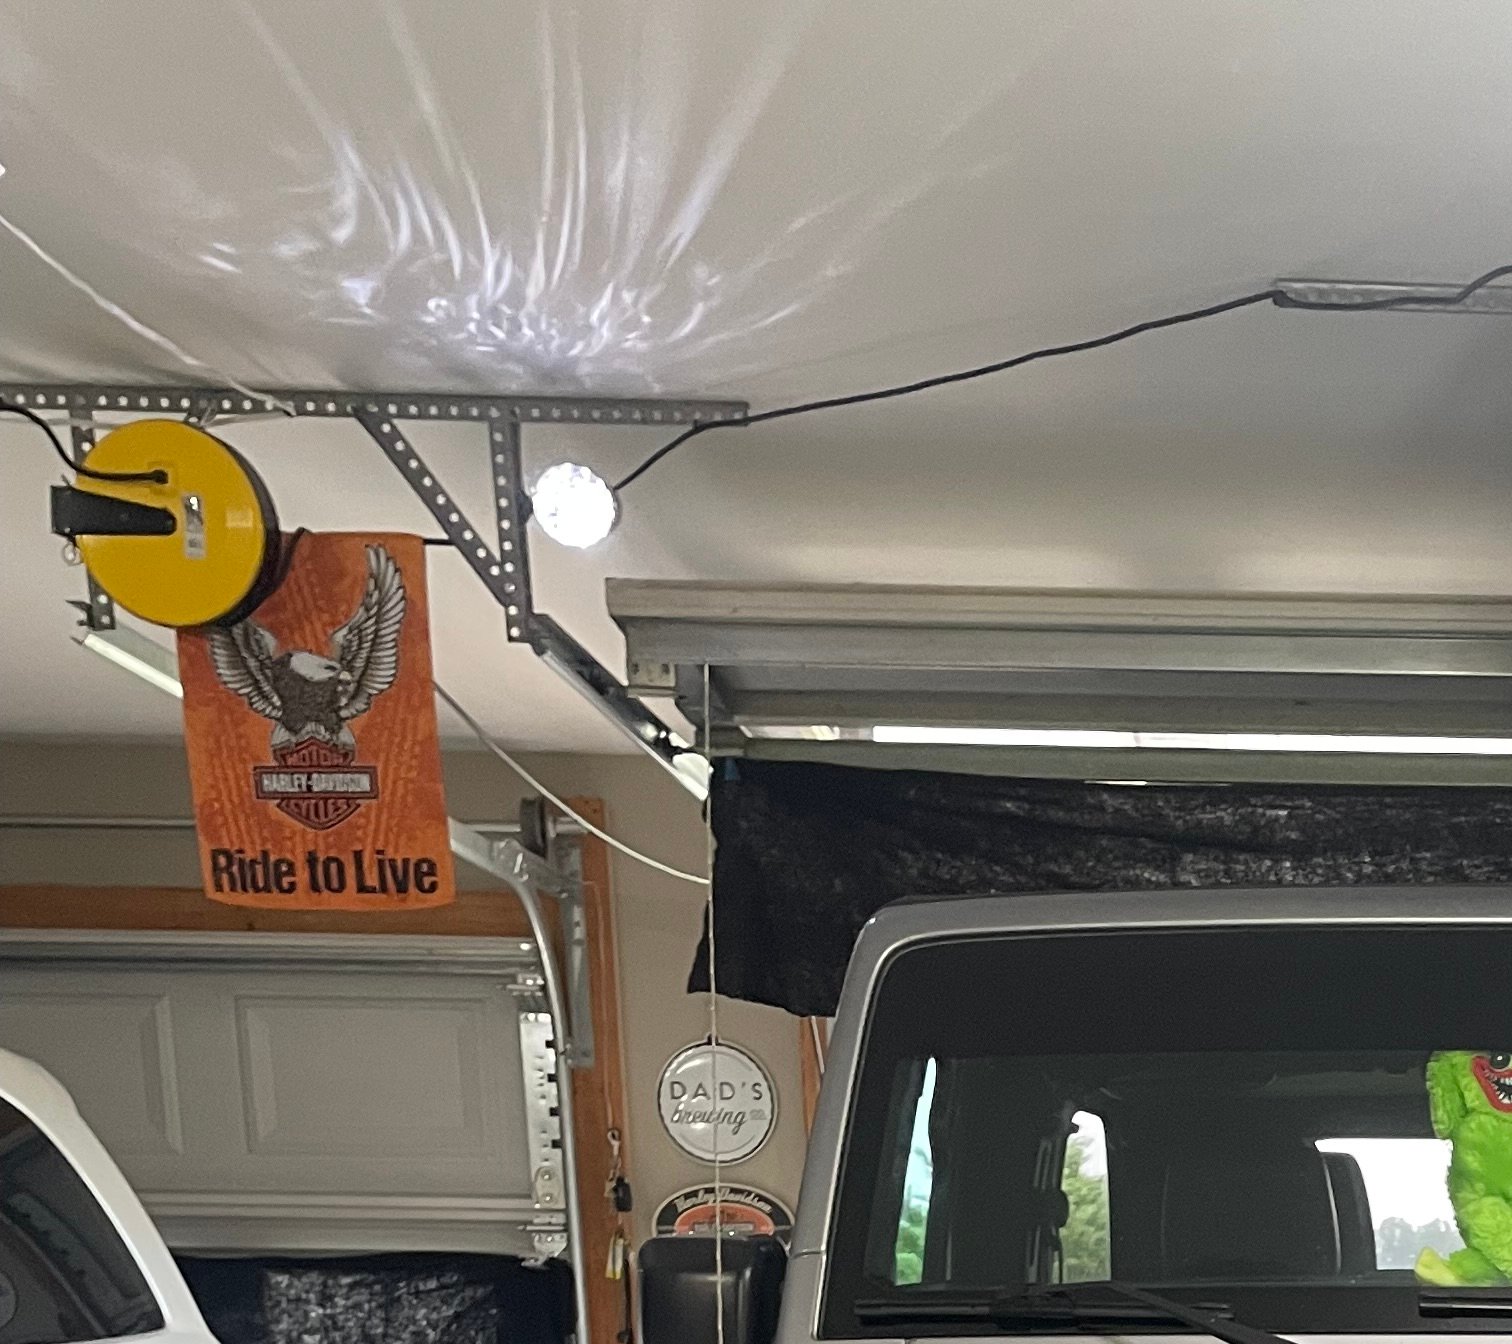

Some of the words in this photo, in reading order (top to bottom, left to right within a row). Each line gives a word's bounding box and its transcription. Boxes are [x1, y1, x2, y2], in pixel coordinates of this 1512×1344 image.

[211, 848, 298, 895] Ride
[305, 850, 348, 894] to
[352, 849, 439, 895] Live
[669, 1080, 764, 1101] DAD'S
